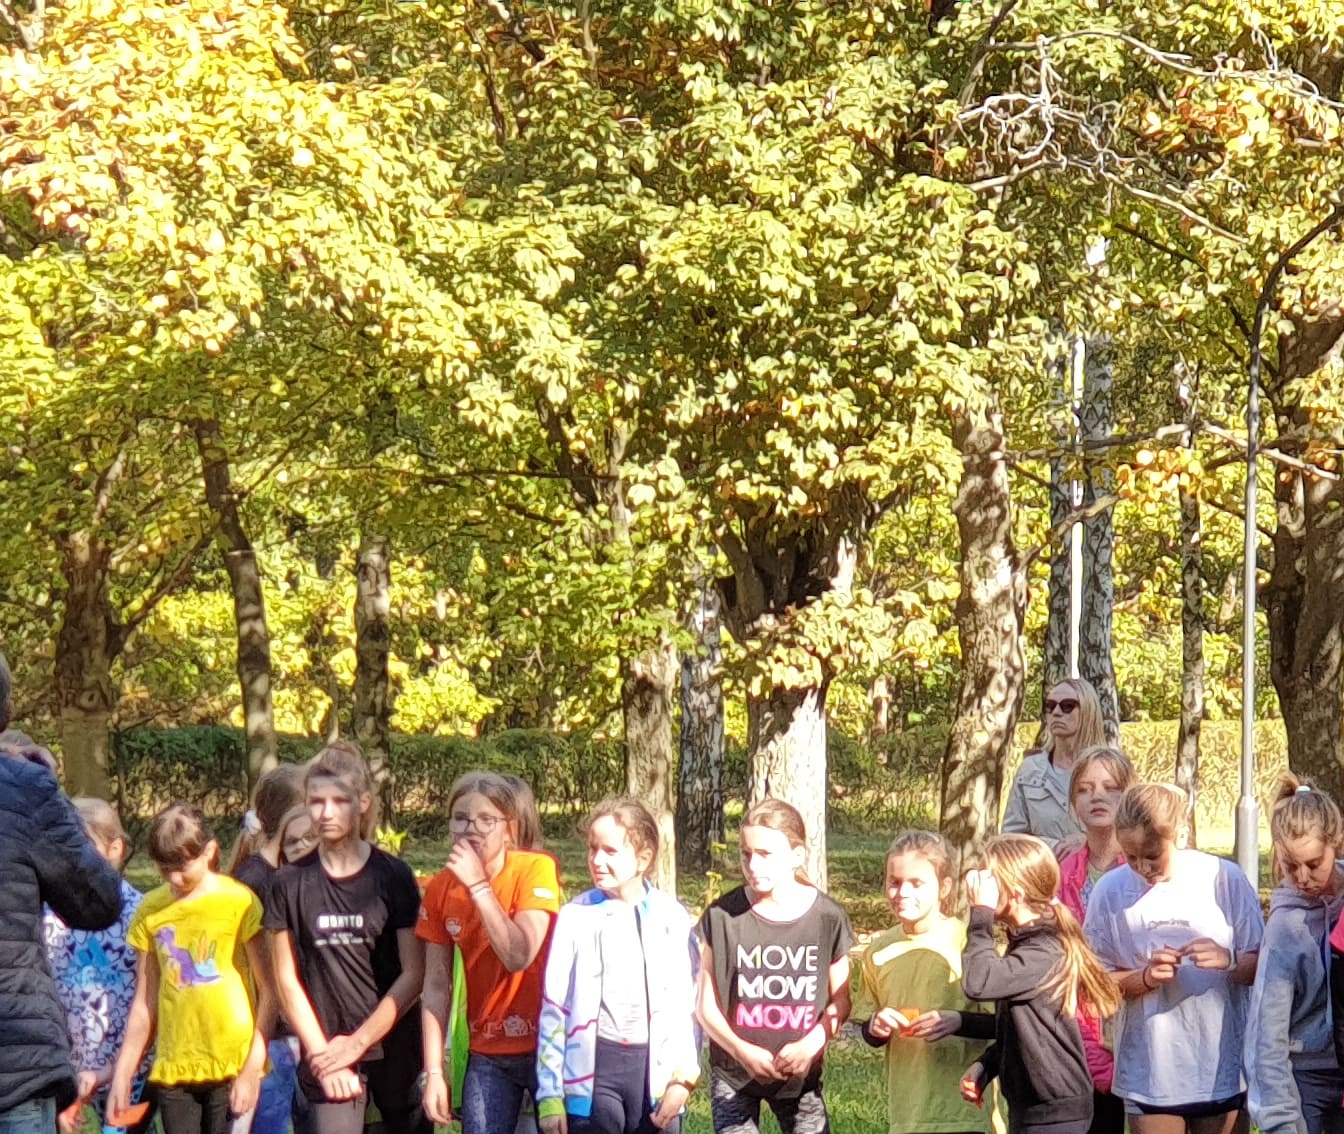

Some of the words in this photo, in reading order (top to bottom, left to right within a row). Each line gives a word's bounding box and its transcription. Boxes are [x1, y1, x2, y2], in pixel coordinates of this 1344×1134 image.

[737, 943, 818, 972] MOVE
[737, 973, 818, 1001] MOVE
[736, 1003, 815, 1029] MOVE
